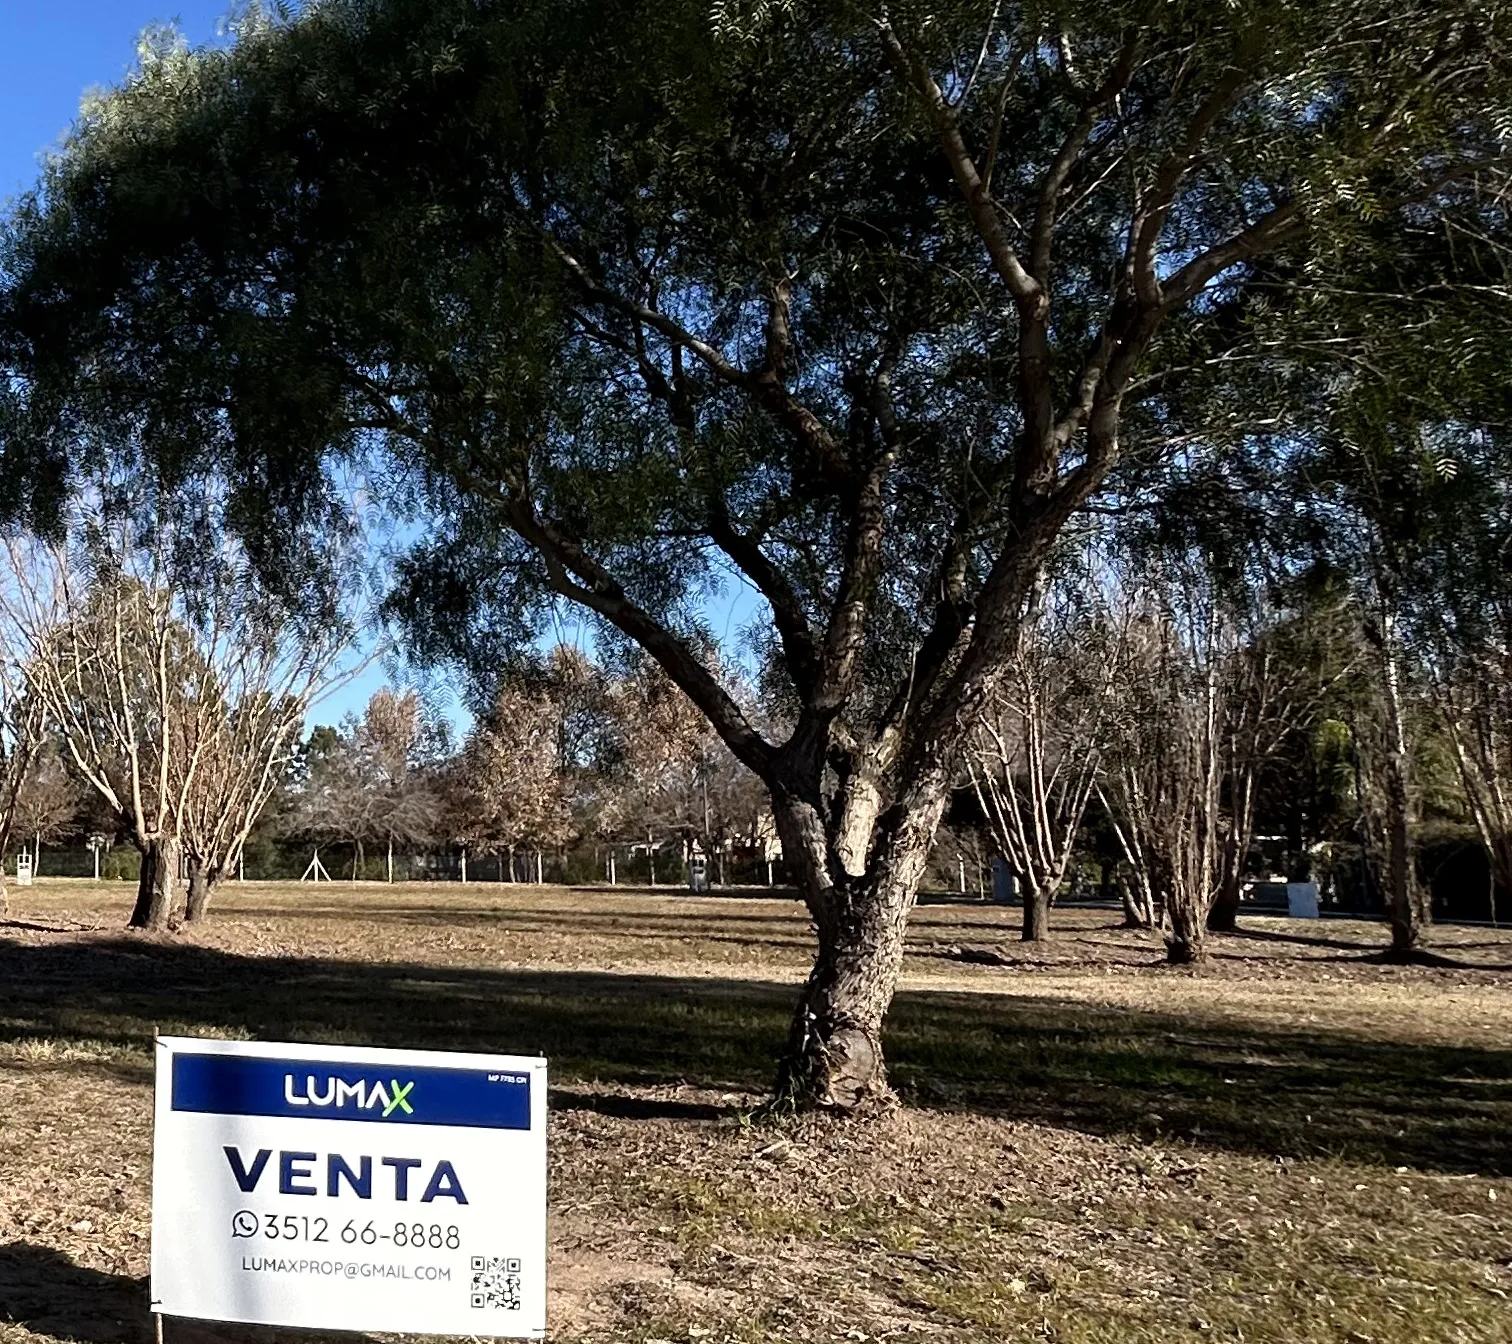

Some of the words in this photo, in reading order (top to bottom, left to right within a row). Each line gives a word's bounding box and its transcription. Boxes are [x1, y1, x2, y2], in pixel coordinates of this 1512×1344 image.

[284, 1074, 414, 1117] LUMAX
[223, 1146, 469, 1205] VENTA
[264, 1213, 329, 1242] 3512
[341, 1219, 461, 1249] 66-8888
[242, 1256, 451, 1282] LUMAXPROP@GMAIL.COM
